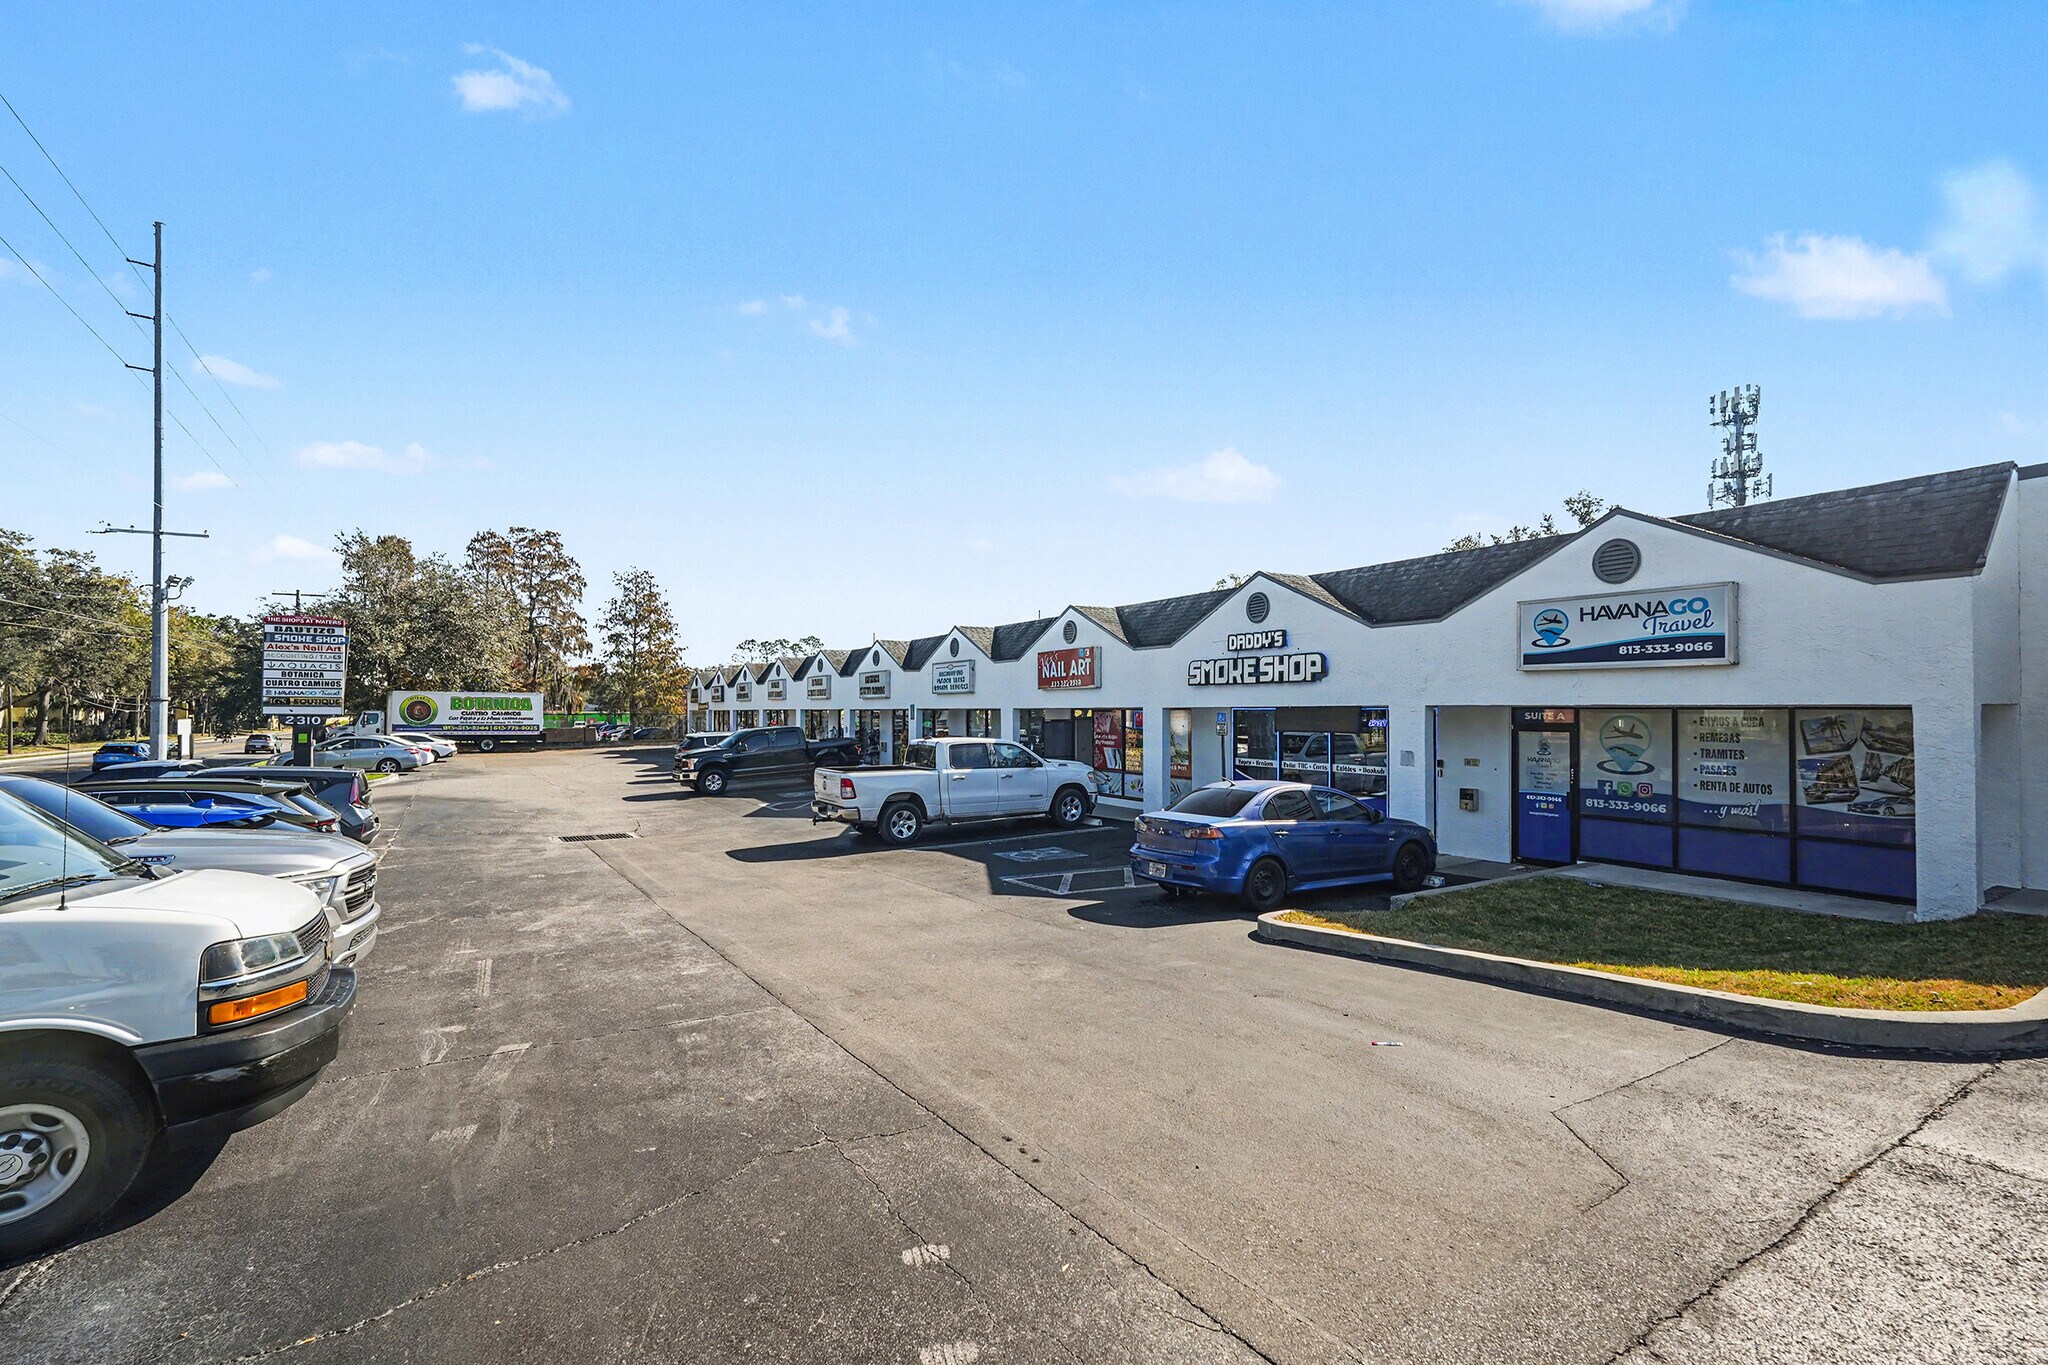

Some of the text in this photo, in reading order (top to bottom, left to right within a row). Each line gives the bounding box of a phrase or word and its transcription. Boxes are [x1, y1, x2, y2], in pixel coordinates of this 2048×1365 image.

[1579, 595, 1710, 622] HAVANAGO
[1642, 608, 1715, 635] Travel
[273, 626, 336, 634] BAUTIZO
[274, 634, 346, 644] SMOKE SHOP
[1228, 630, 1284, 650] DADDY'S
[1618, 641, 1713, 655] 813-333-9066
[1042, 658, 1091, 679] NAIL ART
[1188, 653, 1322, 685] SMOKE SHOP
[265, 679, 300, 687] CUATRO
[450, 696, 533, 711] BOTANICA
[285, 716, 321, 725] 2310
[1524, 712, 1565, 720] SUITE A
[1699, 716, 1730, 727] ENVIOS
[1732, 717, 1739, 727] A
[1699, 732, 1741, 744] REMESAS
[1699, 749, 1745, 760] TRAMITES
[1699, 765, 1737, 776] PASAJES
[1699, 781, 1773, 795] RENTA DE AUTOS
[1585, 798, 1667, 813] 813-333-9066
